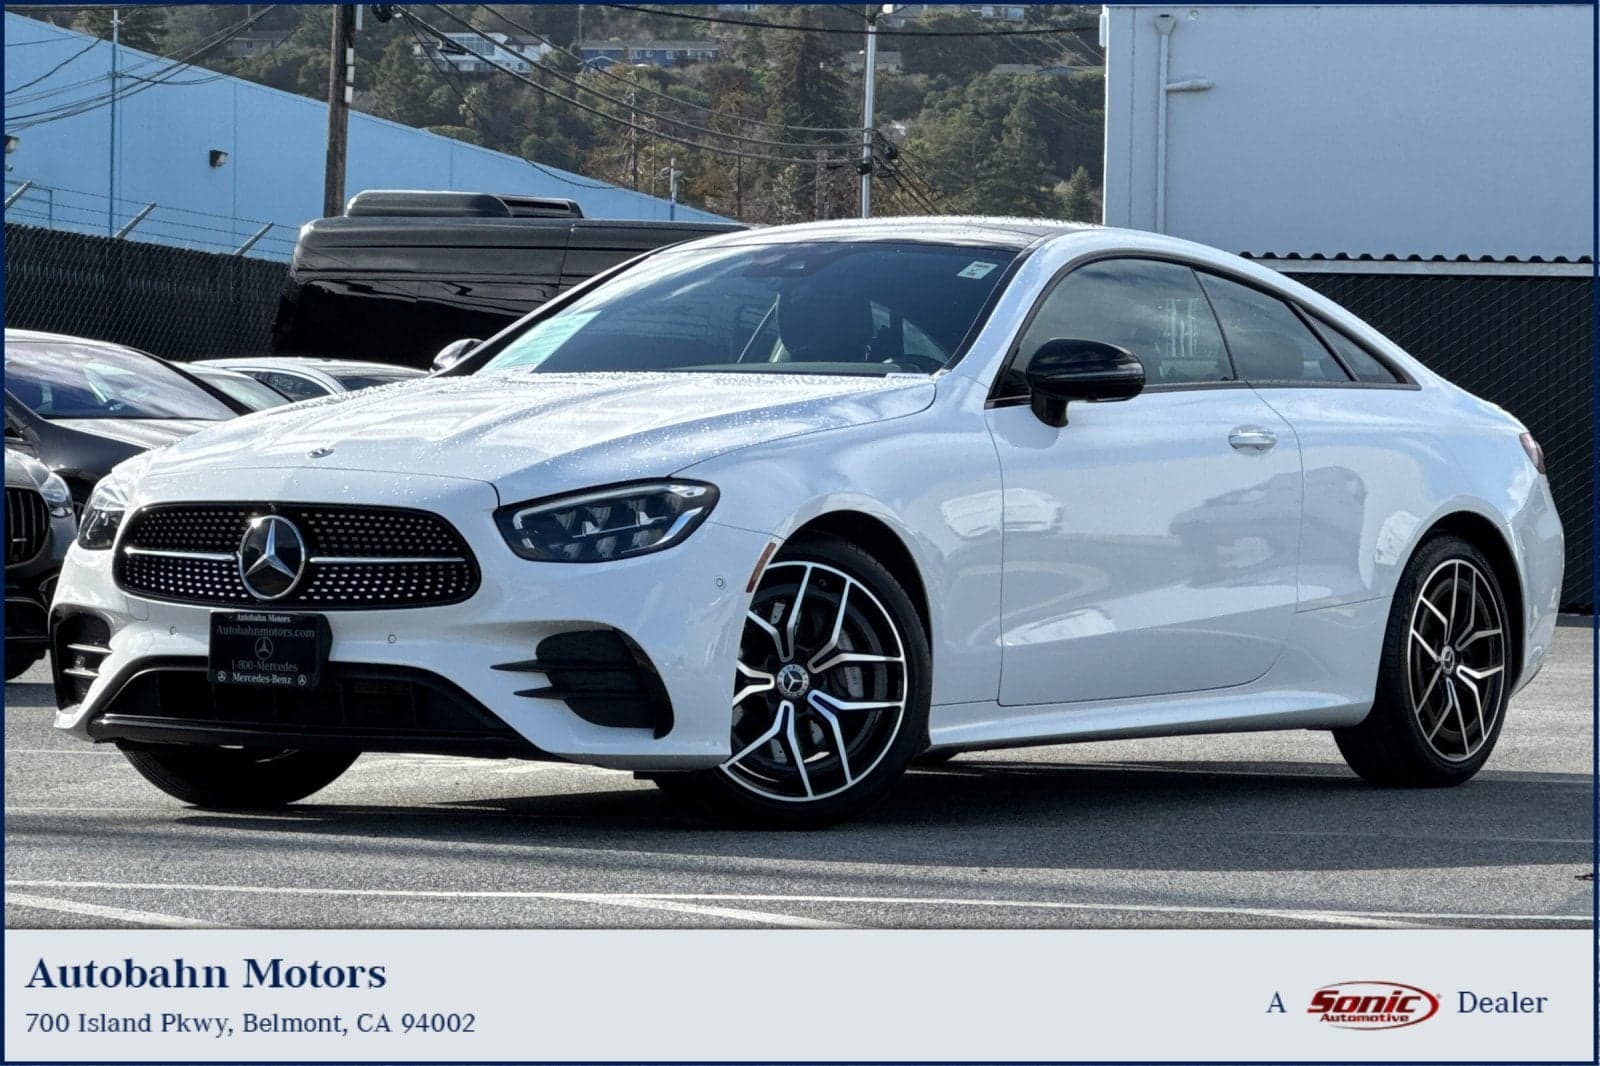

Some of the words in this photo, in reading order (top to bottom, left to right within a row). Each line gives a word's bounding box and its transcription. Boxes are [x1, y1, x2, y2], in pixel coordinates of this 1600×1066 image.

[236, 613, 267, 622] Autobahn
[268, 614, 291, 623] Motors
[216, 624, 315, 638] Autobahnmotors.com
[231, 659, 298, 672] 1-800-Mercedes
[232, 672, 292, 684] Mercedes-Benz
